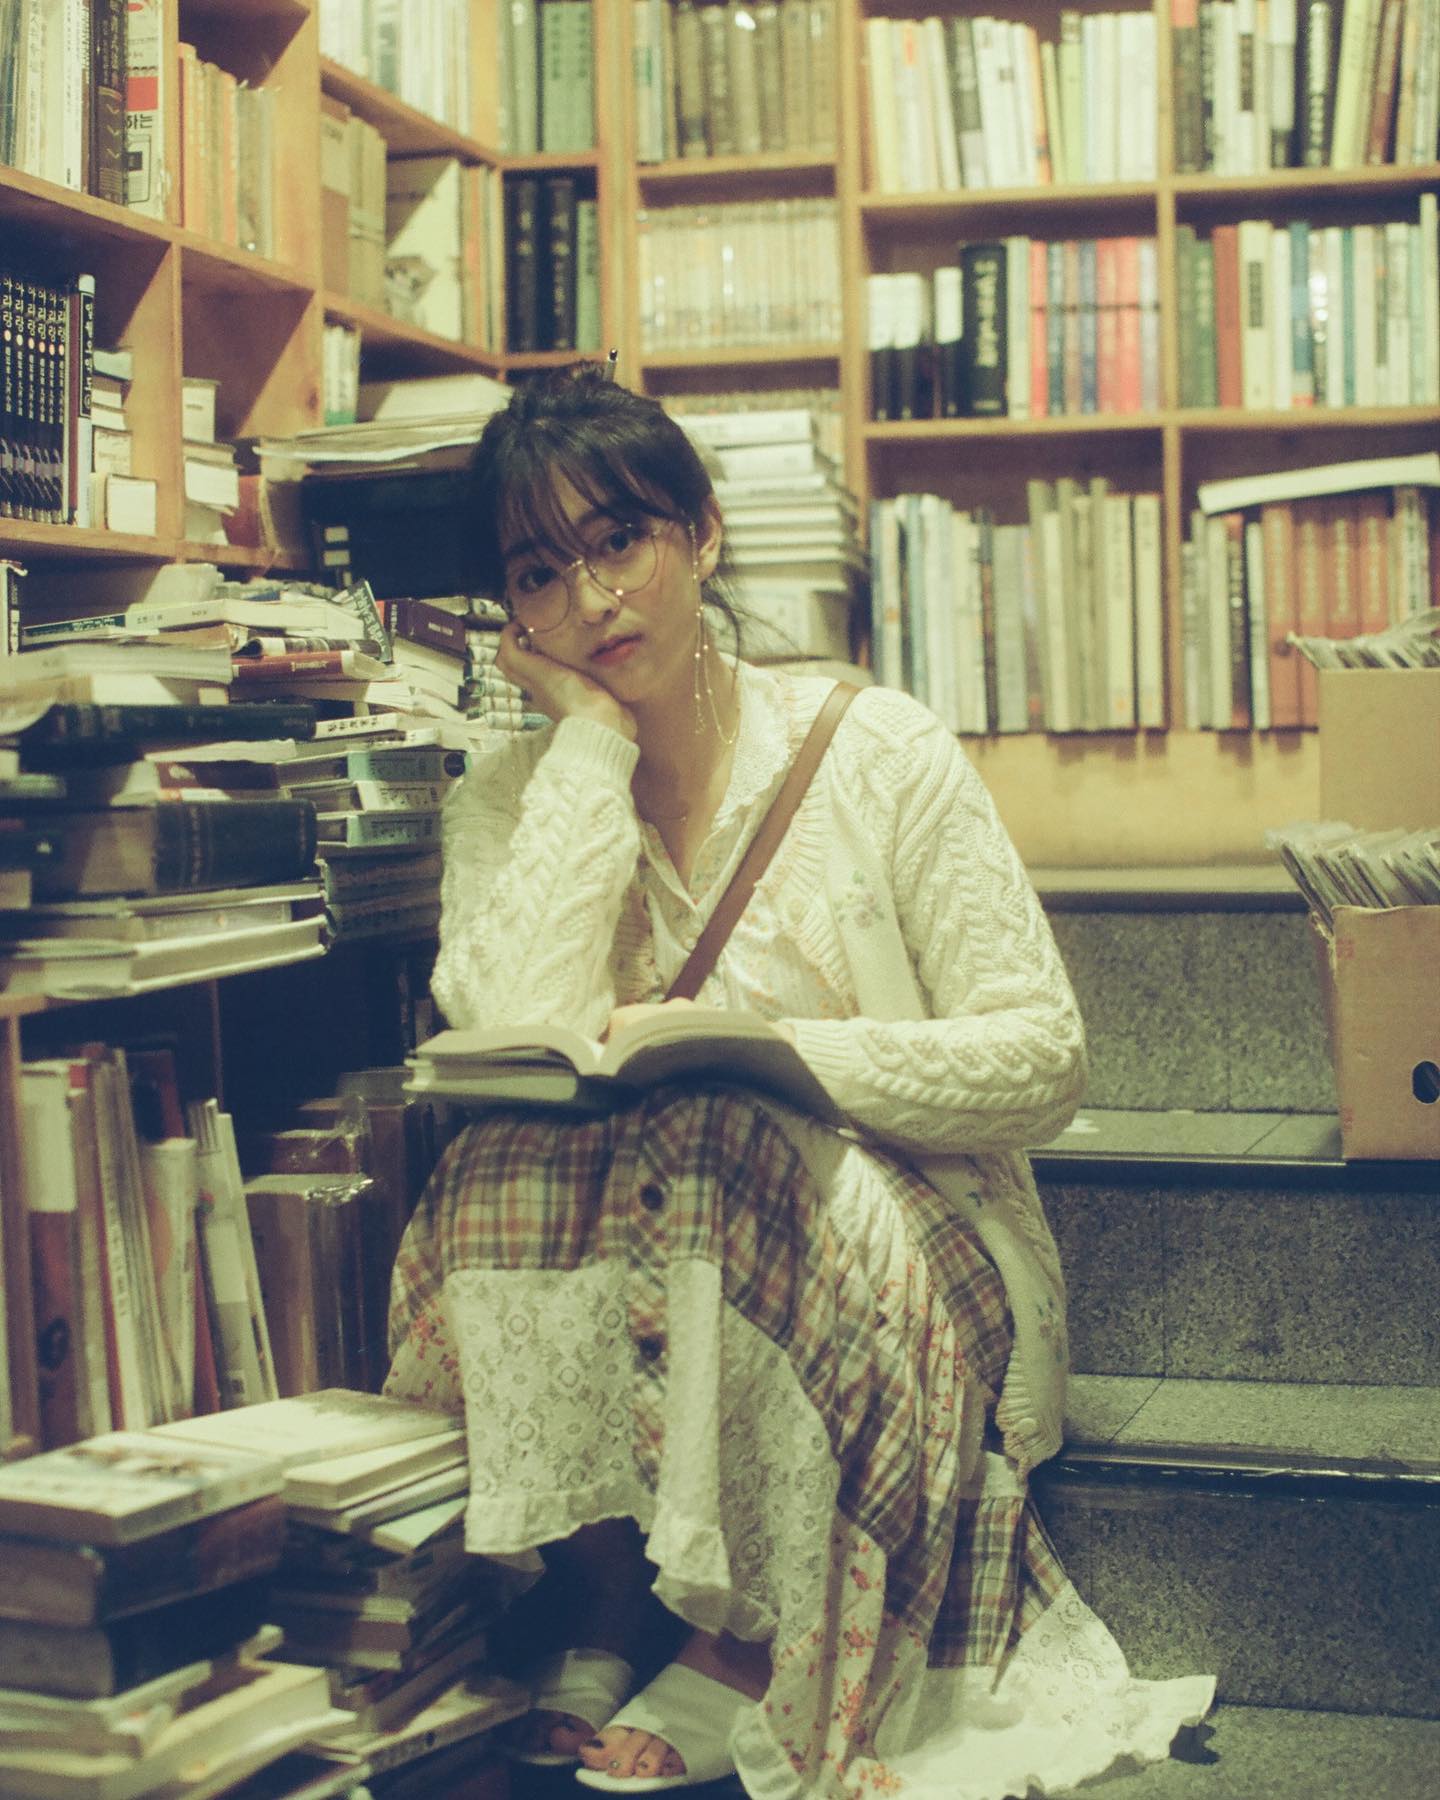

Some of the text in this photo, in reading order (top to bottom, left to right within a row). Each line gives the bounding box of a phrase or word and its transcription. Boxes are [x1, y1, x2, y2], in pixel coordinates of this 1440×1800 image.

[3, 277, 12, 328] 아리랑
[15, 282, 24, 333] 아리랑
[27, 287, 36, 336] 아리랑
[38, 289, 46, 340] 아리랑
